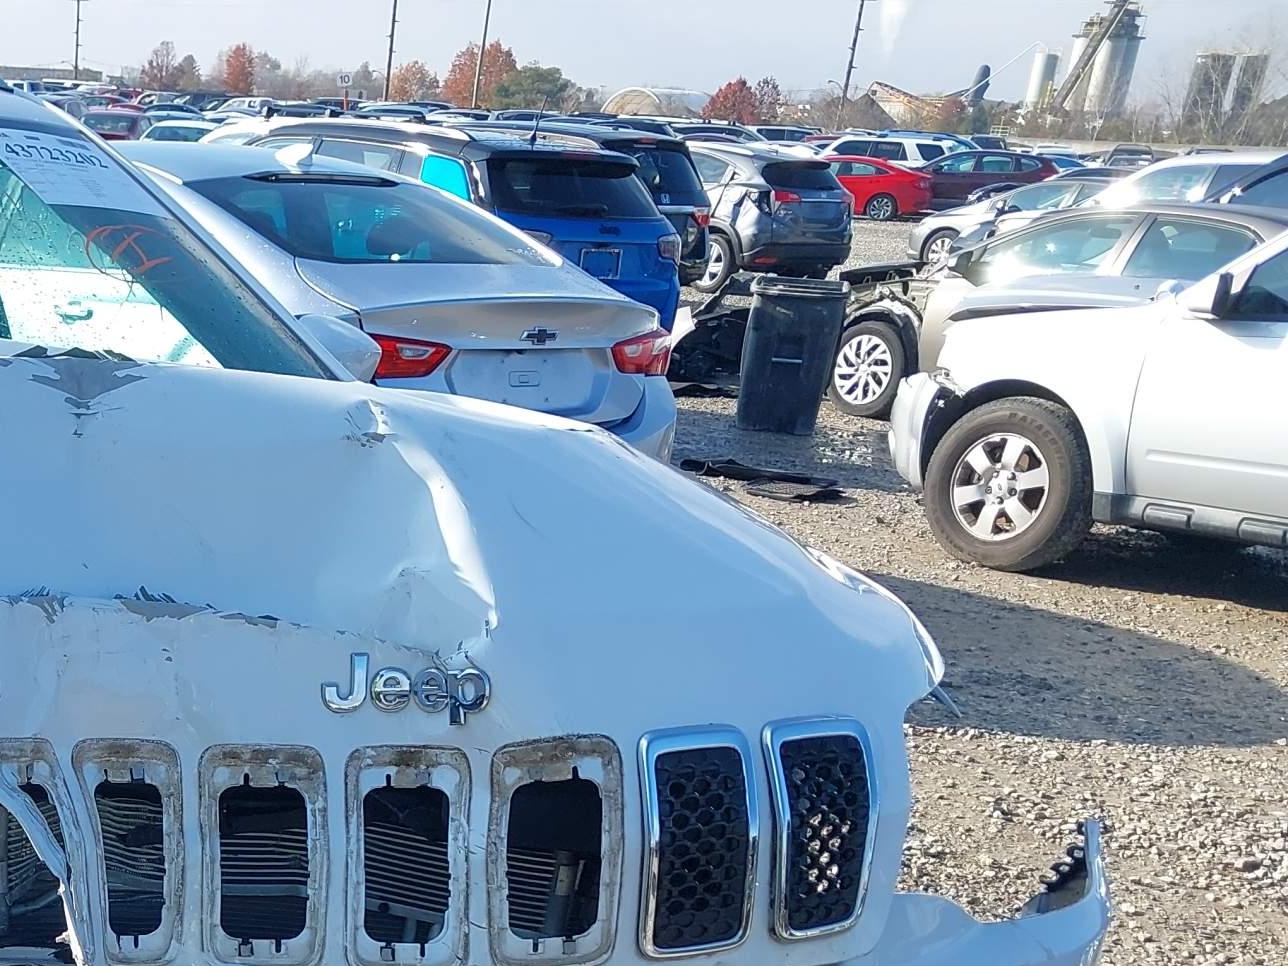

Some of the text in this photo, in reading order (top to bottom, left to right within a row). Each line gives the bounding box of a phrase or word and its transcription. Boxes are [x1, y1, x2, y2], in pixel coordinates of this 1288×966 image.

[338, 74, 350, 84] 10
[4, 142, 109, 169] 43723202
[320, 652, 491, 726] Jeep
